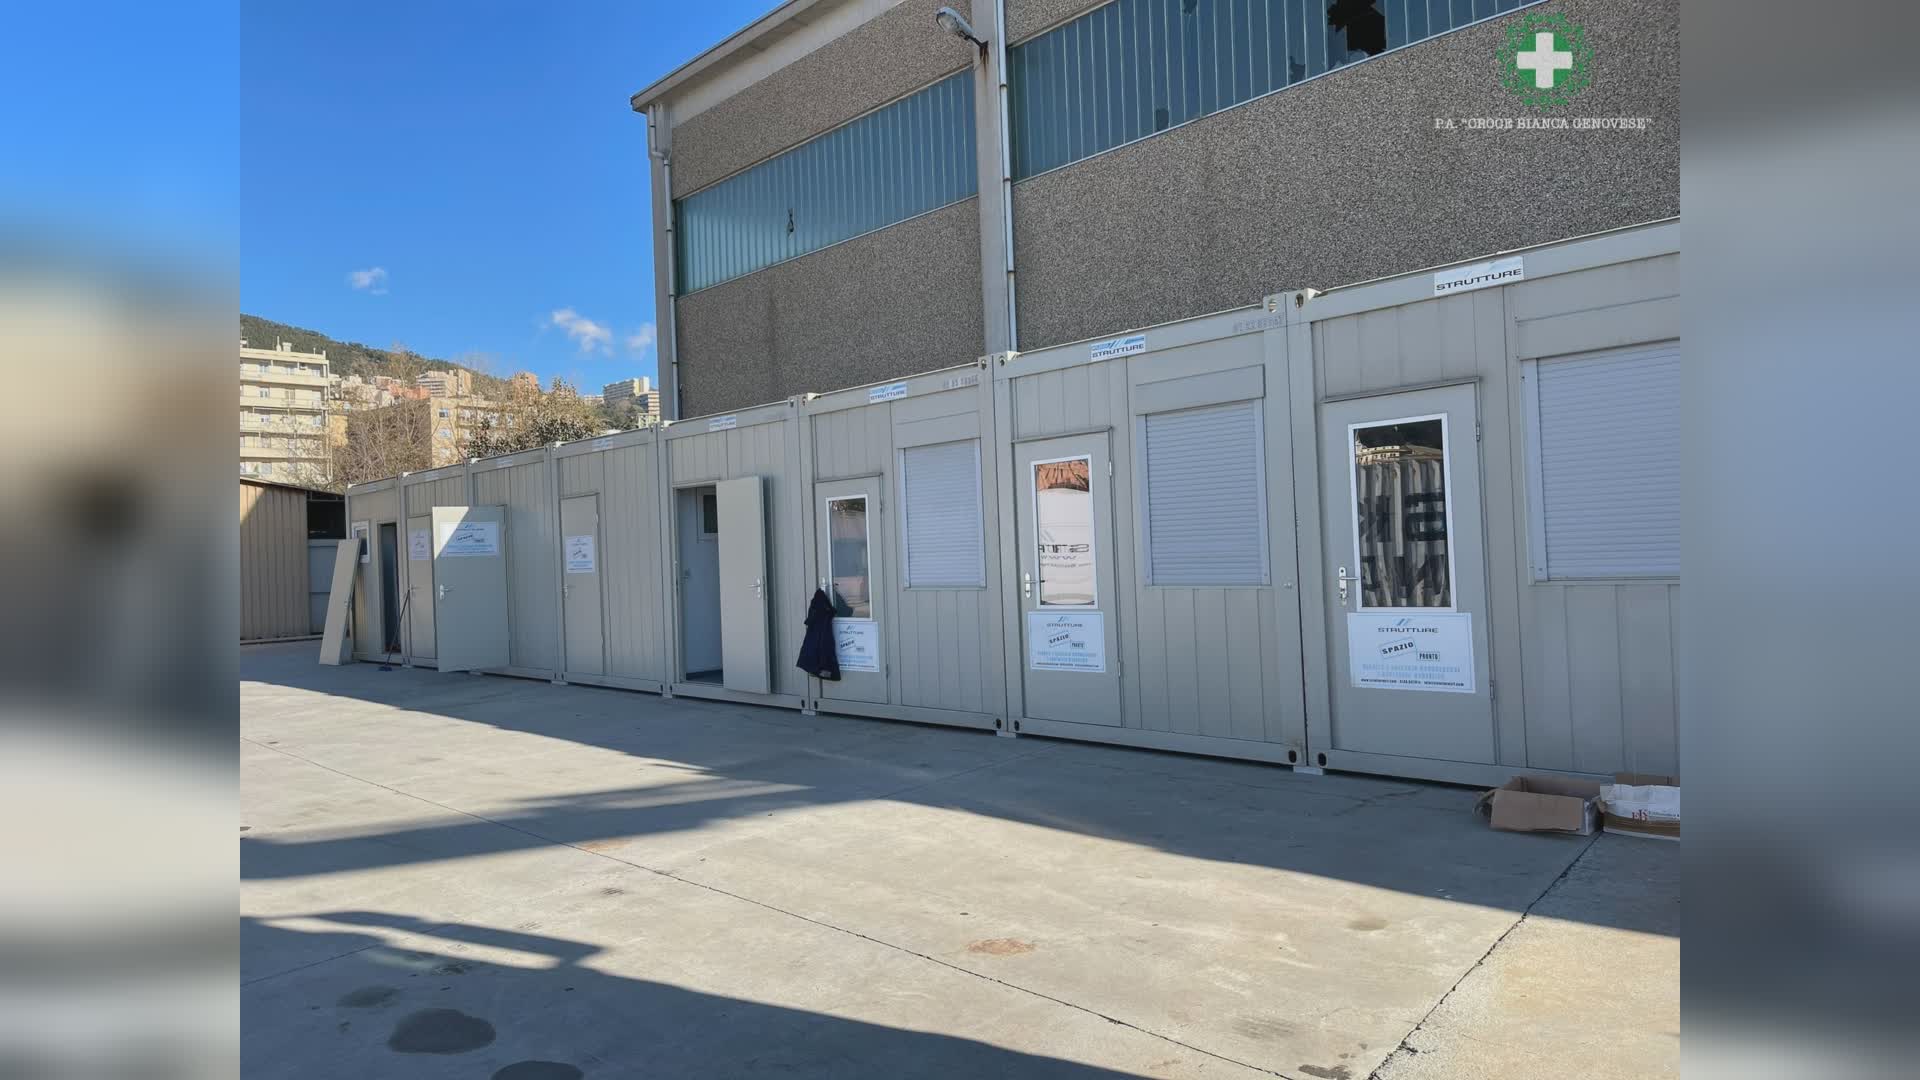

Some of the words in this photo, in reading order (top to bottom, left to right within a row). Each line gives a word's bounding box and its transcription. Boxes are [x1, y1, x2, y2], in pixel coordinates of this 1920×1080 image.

[1436, 268, 1522, 291] STRUTTURE
[1092, 343, 1145, 358] STRUTTURE
[1381, 641, 1415, 655] SPAZIO
